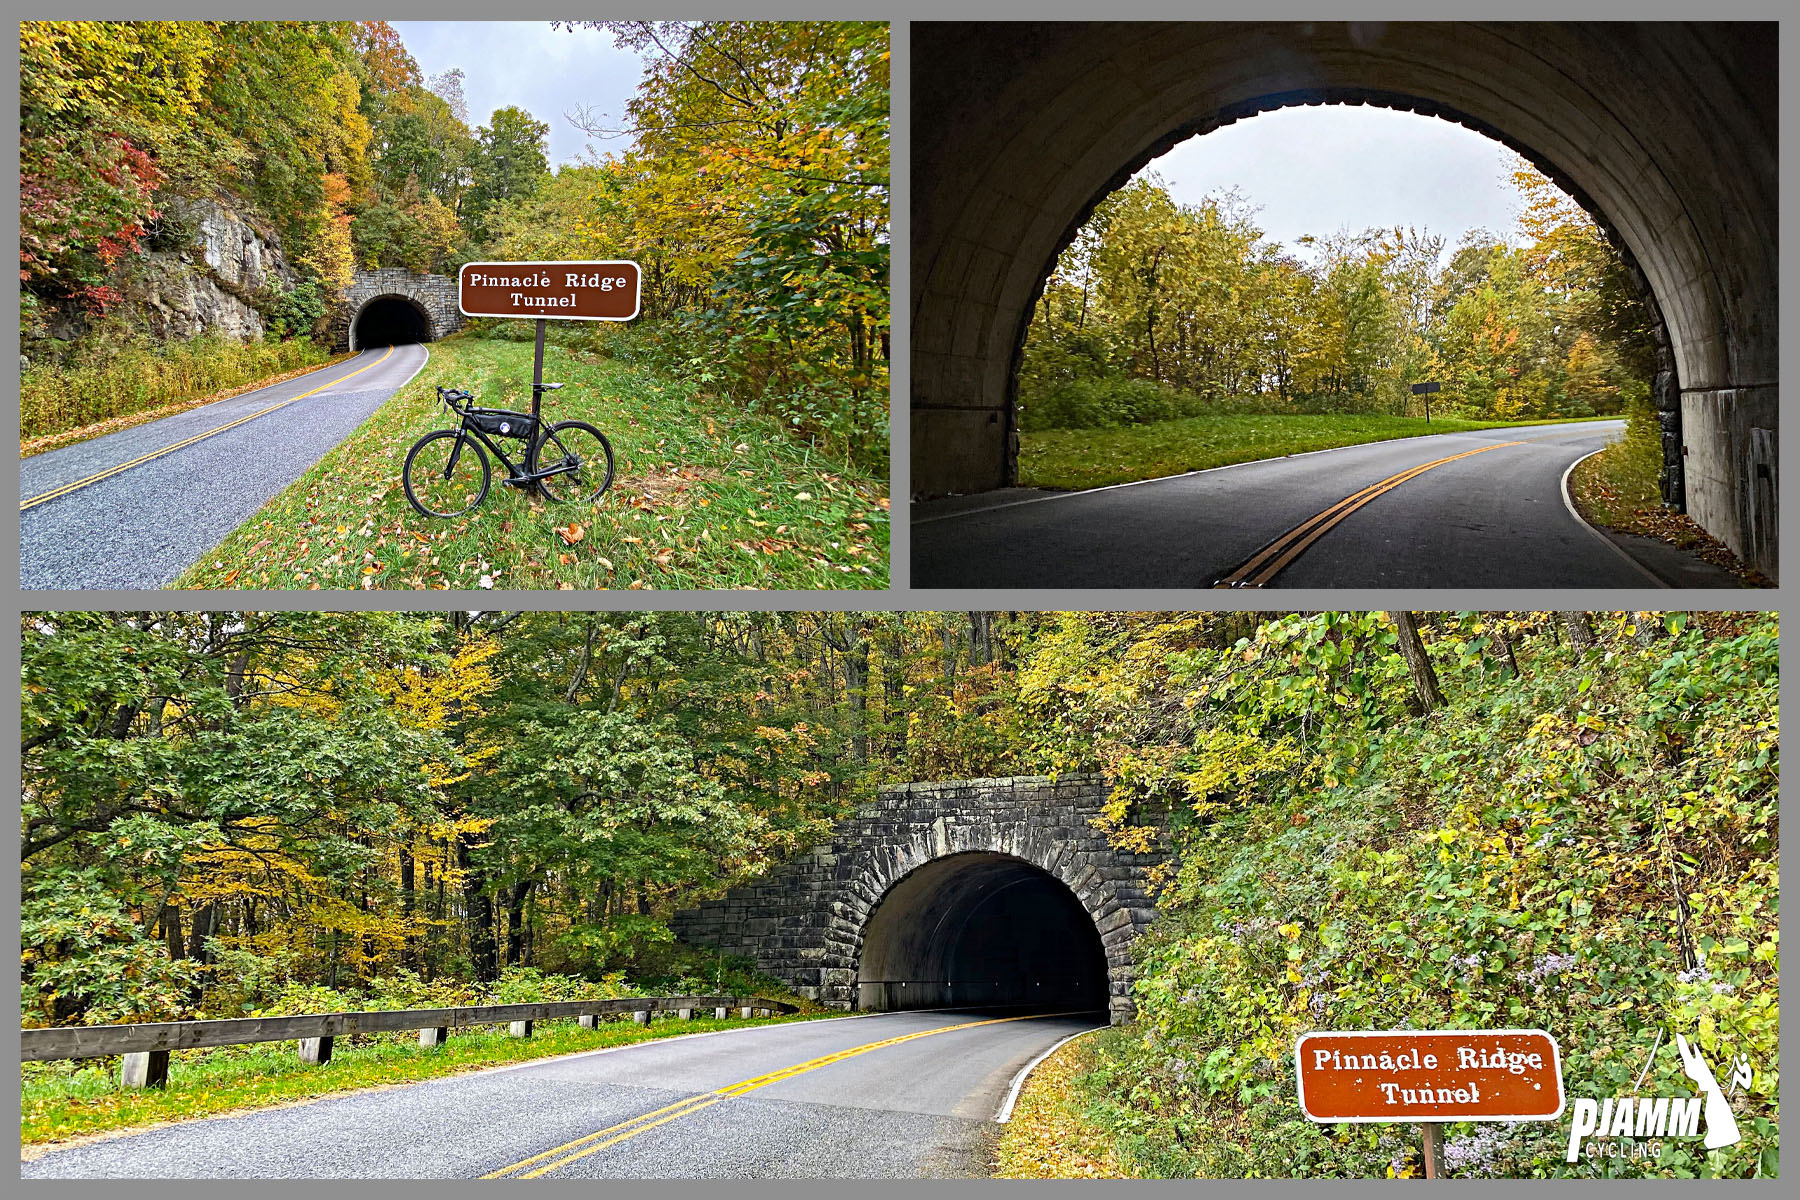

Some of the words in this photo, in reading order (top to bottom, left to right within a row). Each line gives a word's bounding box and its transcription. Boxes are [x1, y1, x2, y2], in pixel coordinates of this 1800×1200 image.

[470, 273, 551, 288] Pinnacle
[565, 273, 627, 292] Ridge
[510, 293, 577, 307] Tunnel
[1313, 1048, 1438, 1071] Pinnacle
[1457, 1047, 1543, 1075] Ridge
[1380, 1082, 1480, 1104] Tunnel
